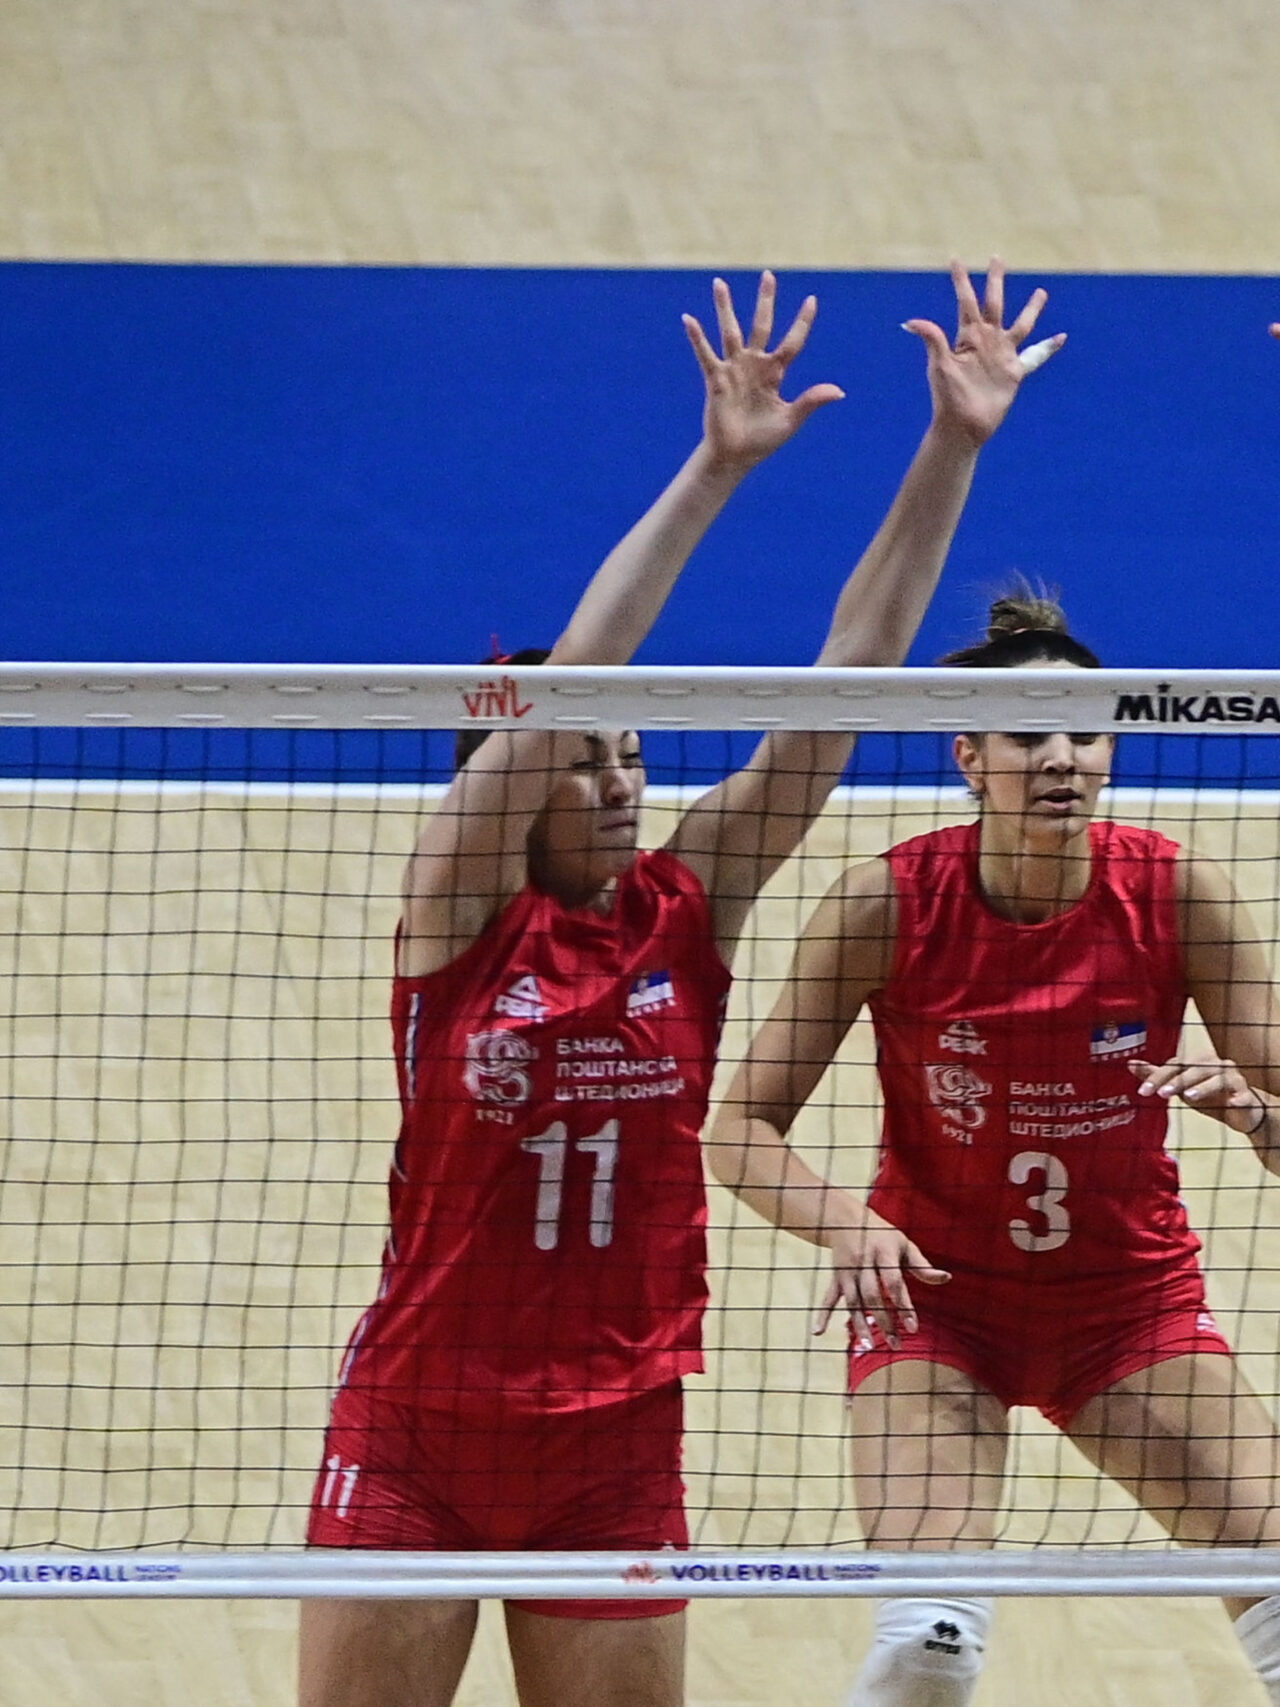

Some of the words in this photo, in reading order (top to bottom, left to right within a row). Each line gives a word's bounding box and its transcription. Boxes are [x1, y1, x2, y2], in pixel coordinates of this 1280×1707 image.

[556, 1038, 625, 1055] БАНКА
[1009, 1081, 1076, 1097] БАНКА
[520, 1118, 621, 1251] 11
[1008, 1150, 1071, 1252] 3
[320, 1454, 360, 1518] 11
[670, 1564, 830, 1581] VOLLEYBALL
